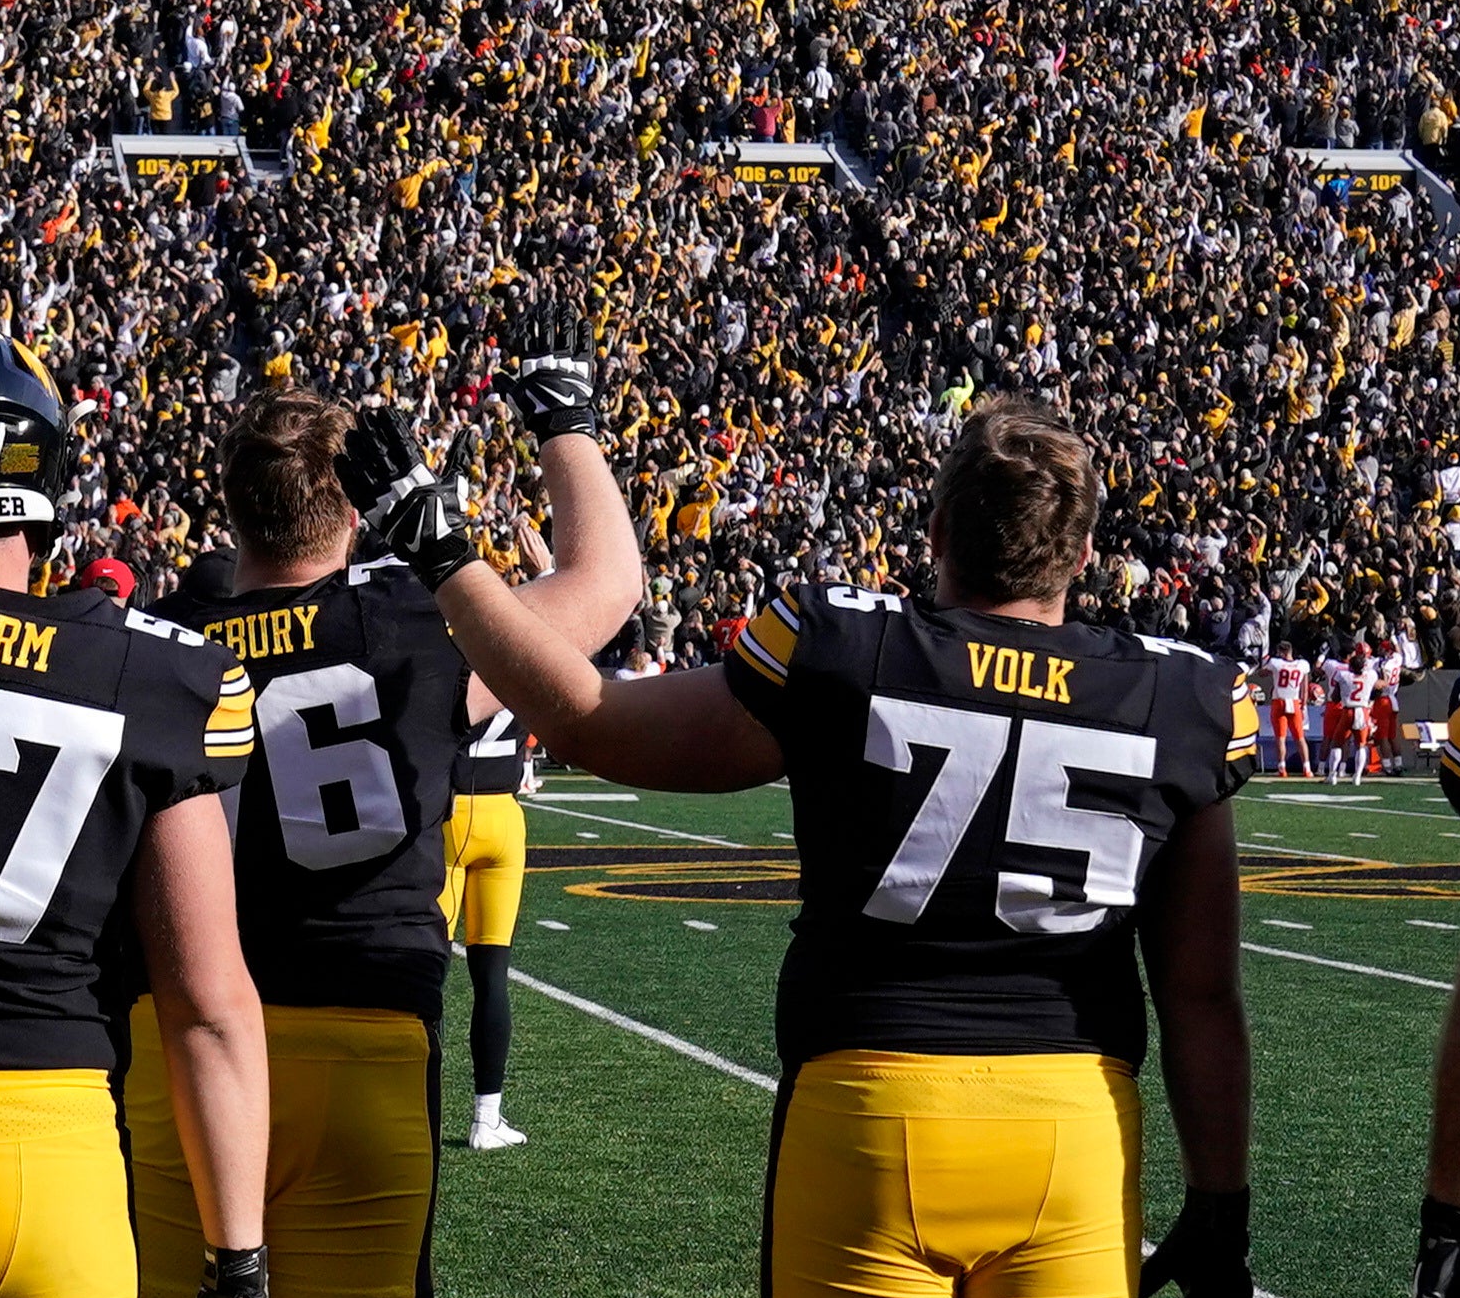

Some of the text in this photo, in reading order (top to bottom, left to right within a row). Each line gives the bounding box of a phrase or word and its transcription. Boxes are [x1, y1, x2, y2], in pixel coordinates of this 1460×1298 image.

[734, 166, 766, 183] 106
[966, 642, 1076, 704] VOLK
[1278, 668, 1301, 688] 89
[1350, 680, 1364, 701] 2
[862, 694, 1157, 934] 75
